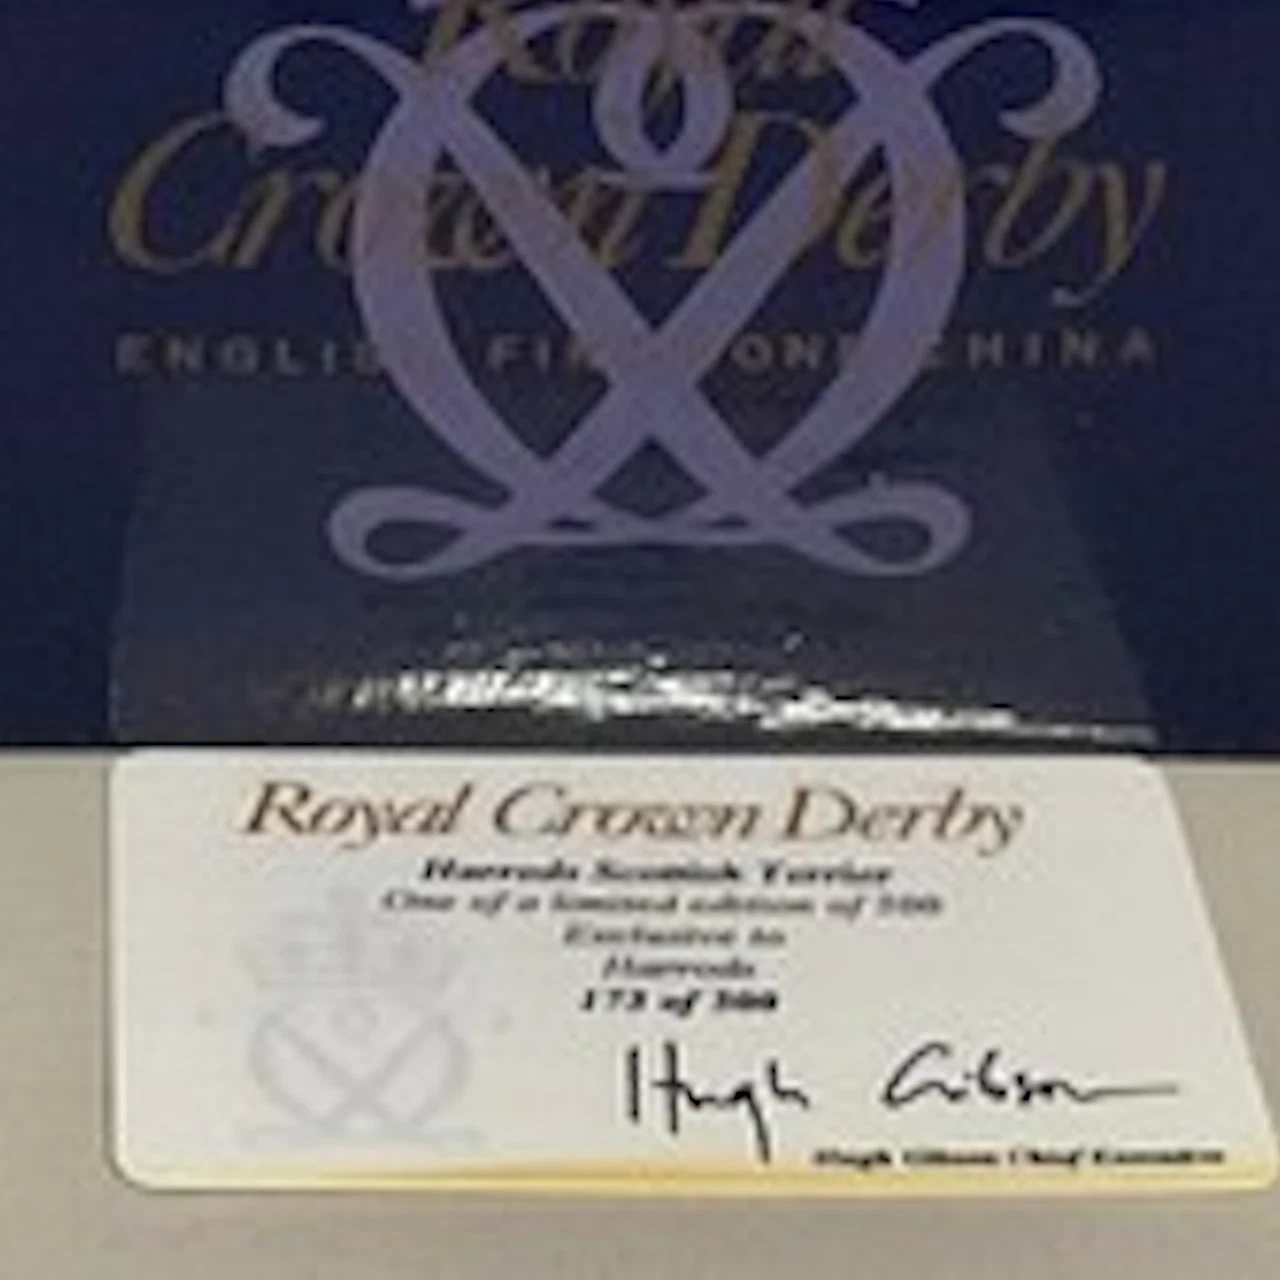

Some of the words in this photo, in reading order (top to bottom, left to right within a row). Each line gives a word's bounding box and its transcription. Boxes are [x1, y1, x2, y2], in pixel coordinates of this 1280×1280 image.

[115, 330, 422, 378] ENGLIS
[242, 780, 476, 851] Royal
[492, 781, 766, 840] Crown
[780, 783, 1026, 856] Derby
[419, 857, 581, 884] Harrods
[758, 859, 894, 885] Terrier
[380, 889, 458, 914] One
[468, 889, 513, 921] of
[550, 889, 681, 915] limited
[686, 889, 817, 915] edition
[823, 890, 869, 922] of
[562, 924, 738, 948] Exclusive
[747, 925, 788, 948] to
[601, 955, 758, 981] Harrods
[656, 987, 702, 1019] of
[626, 1040, 810, 1164] Hugh
